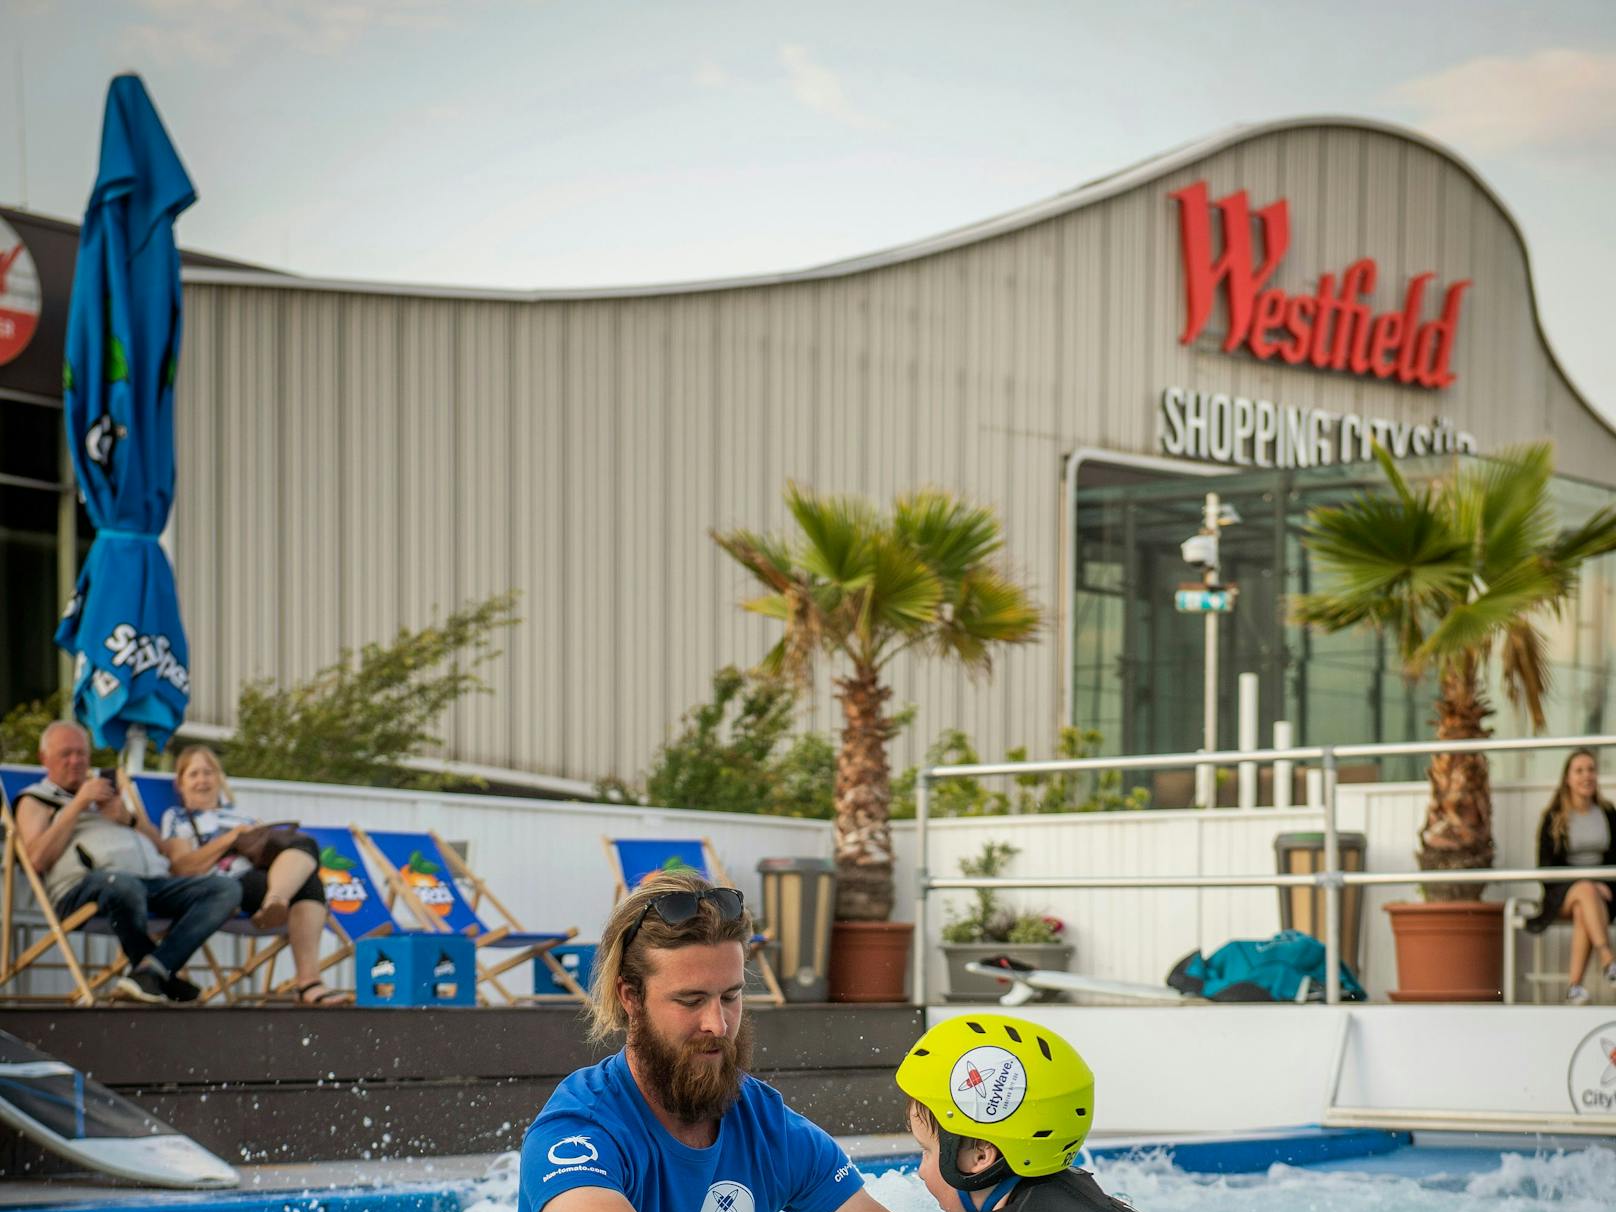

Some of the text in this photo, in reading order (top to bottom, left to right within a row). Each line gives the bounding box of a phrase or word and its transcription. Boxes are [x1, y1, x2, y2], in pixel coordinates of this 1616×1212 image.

[1167, 179, 1474, 389] Westfield
[1161, 386, 1333, 468] SHOPPING
[985, 1060, 1014, 1116] CityWave.
